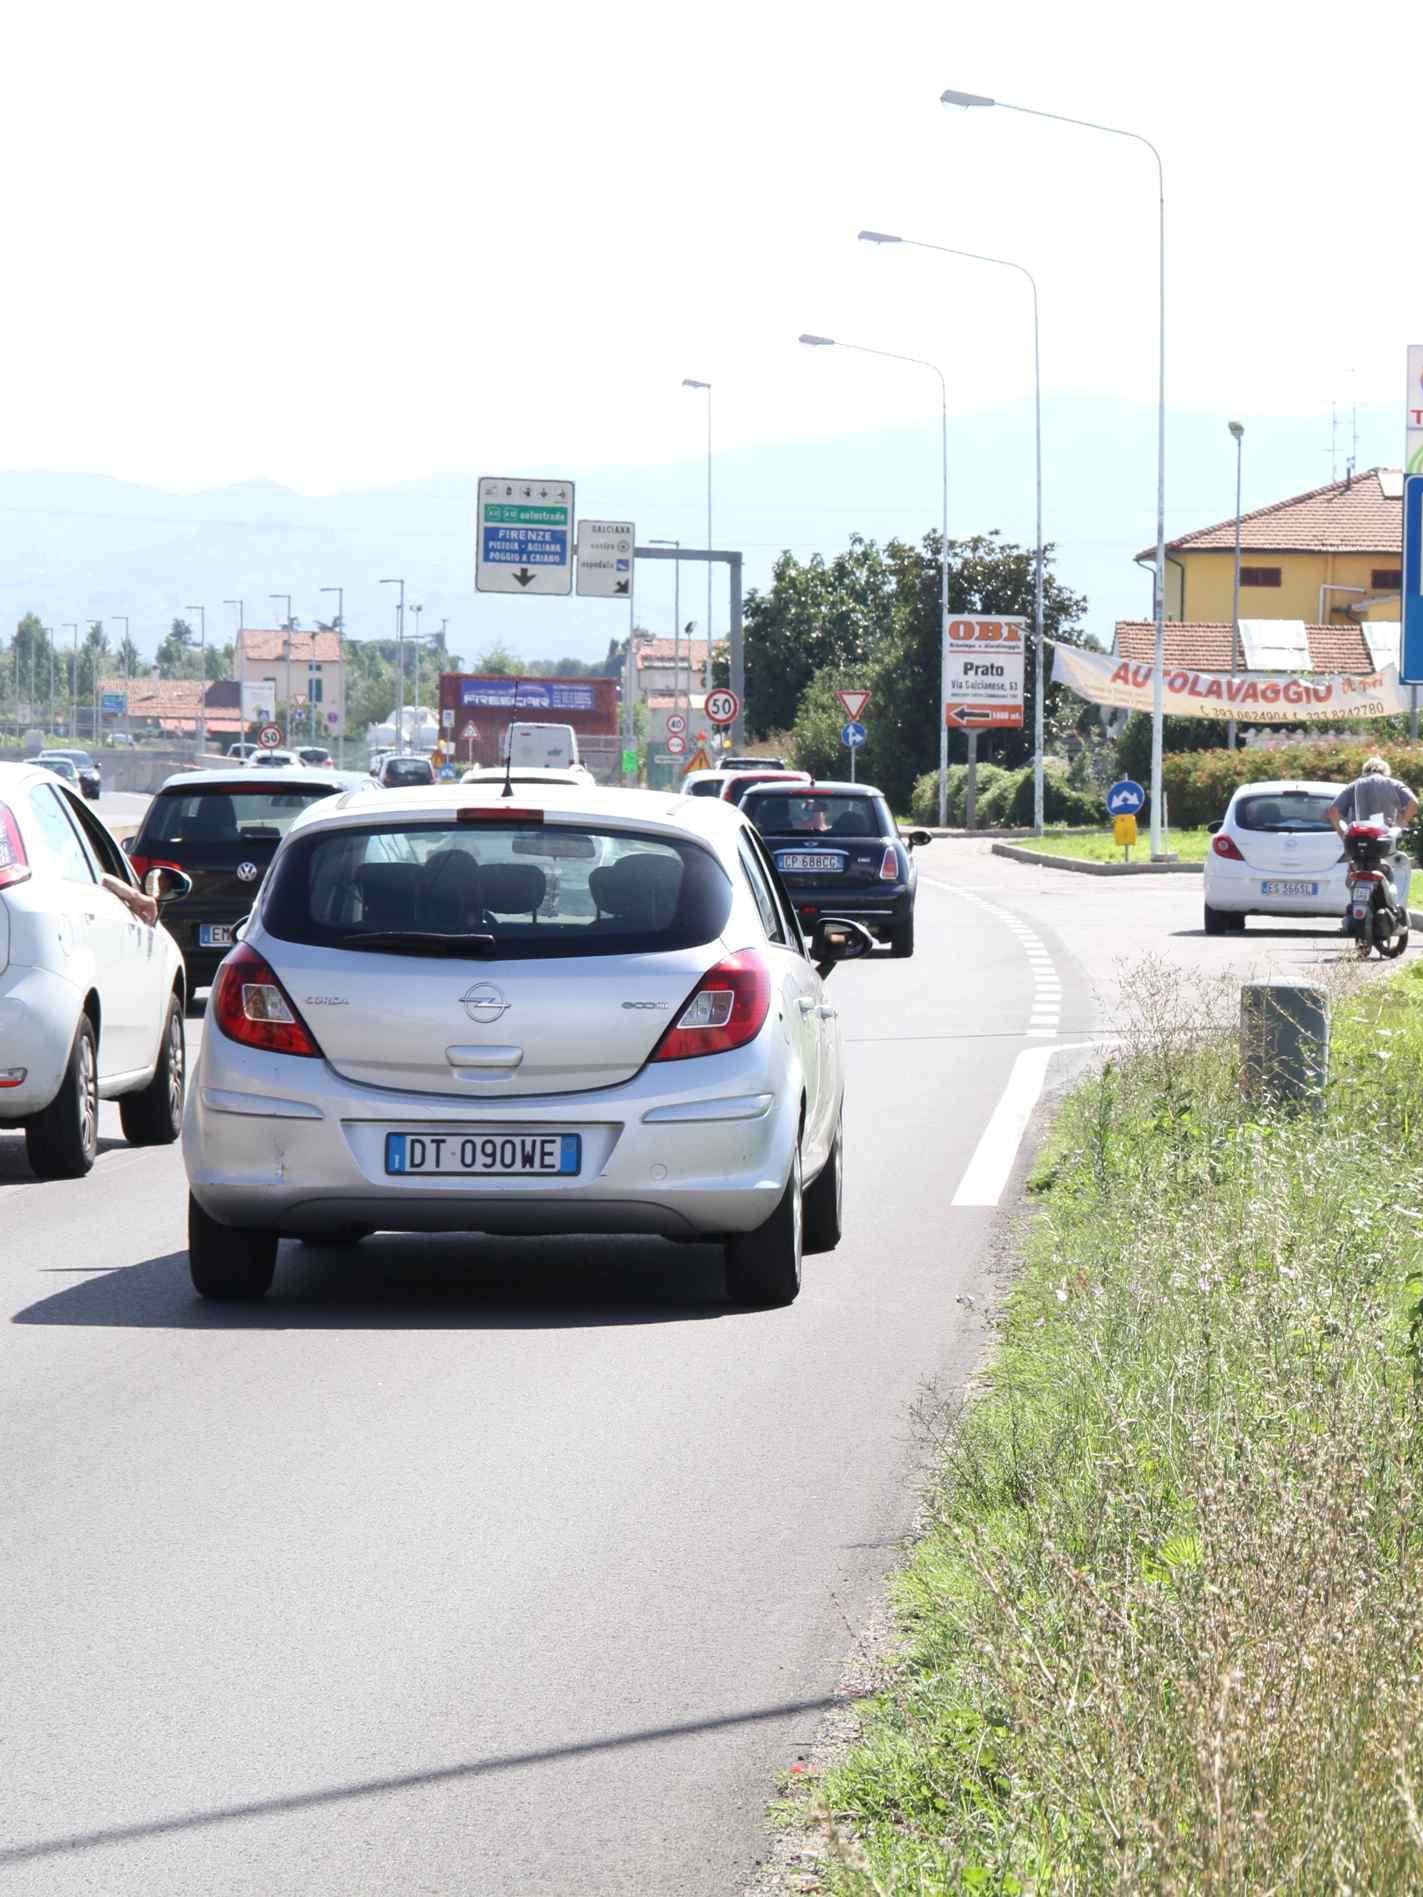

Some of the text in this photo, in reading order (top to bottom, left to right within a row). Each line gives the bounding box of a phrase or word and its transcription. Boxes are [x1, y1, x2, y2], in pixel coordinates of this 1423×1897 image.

[498, 530, 552, 541] FIRENZE
[948, 621, 1022, 641] OBI
[963, 661, 1004, 676] Prato
[951, 680, 963, 689] Via
[711, 698, 731, 715] 50
[671, 721, 682, 729] 40
[263, 732, 278, 744] 50
[785, 856, 798, 868] CP
[409, 1138, 557, 1169] DT 090WE
